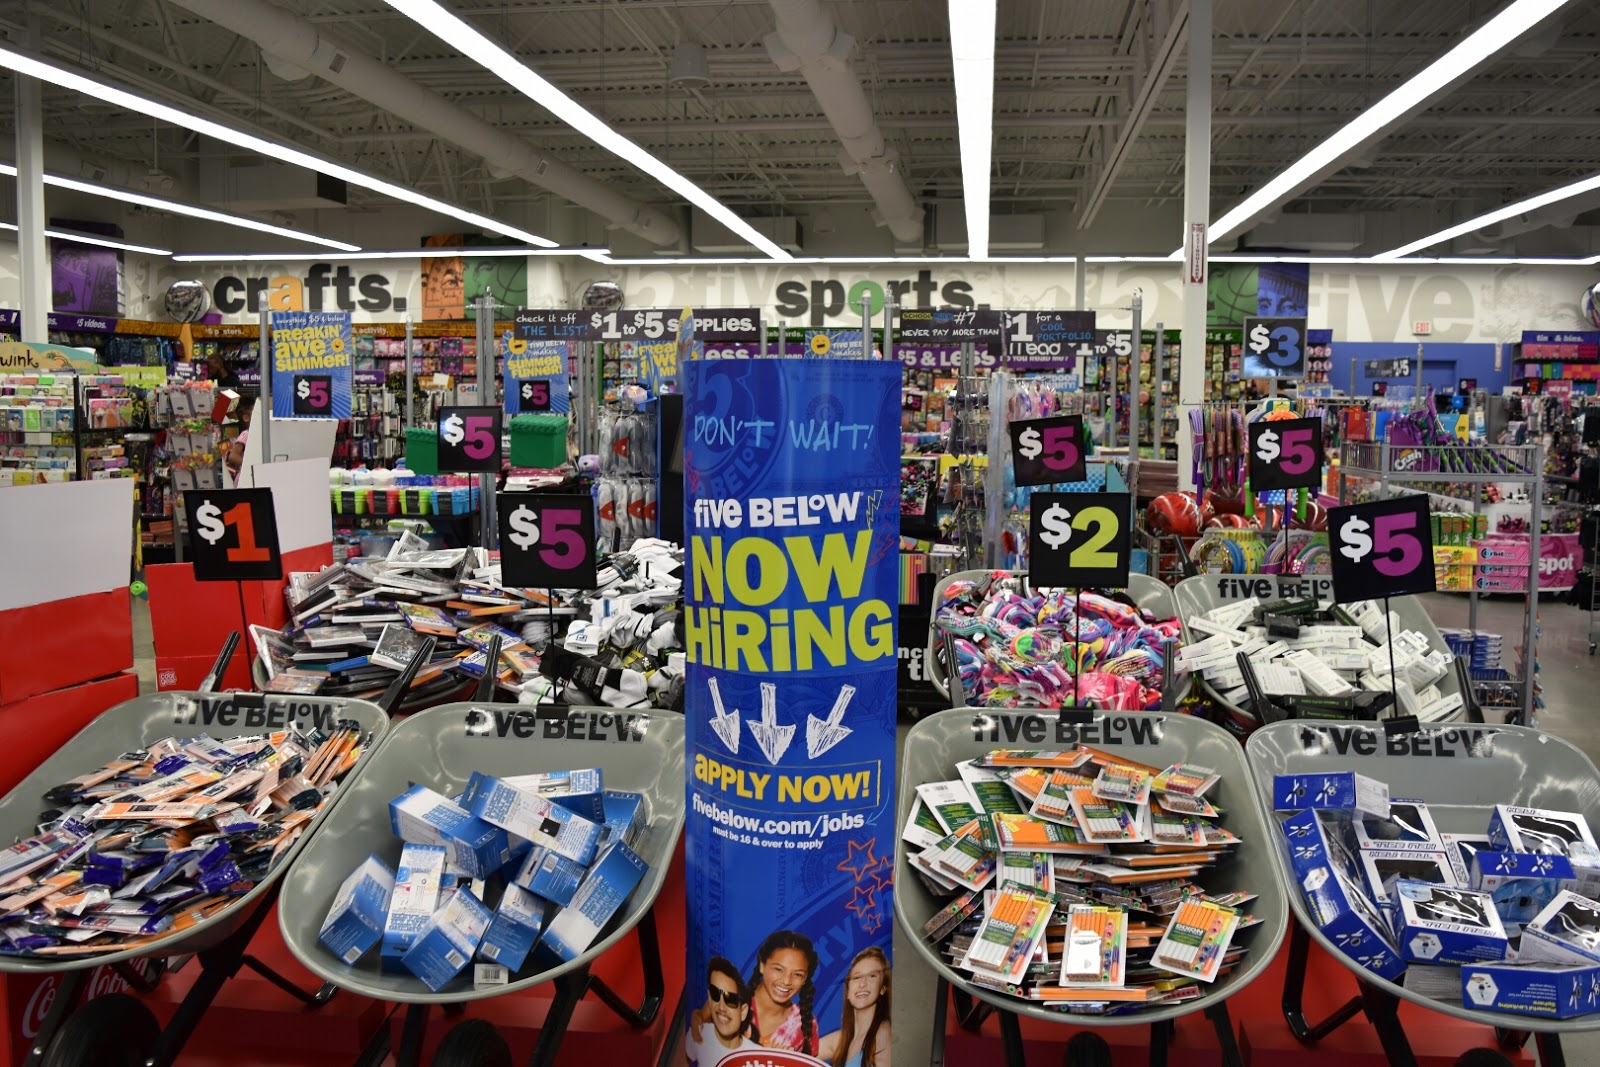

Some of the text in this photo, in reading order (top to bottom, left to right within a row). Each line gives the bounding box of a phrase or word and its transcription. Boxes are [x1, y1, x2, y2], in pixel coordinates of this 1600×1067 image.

[213, 263, 407, 314] crafts.
[776, 270, 991, 326] sports.
[516, 313, 577, 324] check it off
[522, 325, 588, 337] THE LIST!
[633, 311, 665, 339] $5
[902, 312, 932, 320] SCHOOL
[953, 311, 976, 325] #7
[902, 328, 1000, 337] NEVER PAY MORE THAN
[1036, 312, 1052, 324] for
[1040, 323, 1066, 332] COOL
[1036, 332, 1094, 342] PORTFOLIO.
[1248, 323, 1301, 368] $3
[297, 378, 329, 408] $5
[521, 382, 548, 406] $5
[443, 413, 496, 460] $5
[694, 415, 874, 451] DON'T WAIT!
[1018, 426, 1079, 471] $5
[1256, 428, 1316, 475] $5
[694, 499, 742, 528] five
[196, 500, 270, 562] $1
[508, 504, 587, 571] $5
[1039, 502, 1119, 568] $2
[1339, 511, 1423, 577] $5
[690, 529, 873, 607] NOW
[1218, 578, 1272, 599] five
[777, 770, 871, 803] NOW!
[692, 792, 864, 838] fivebelow.com/jobs
[712, 826, 823, 851] must be 16 & over to apply
